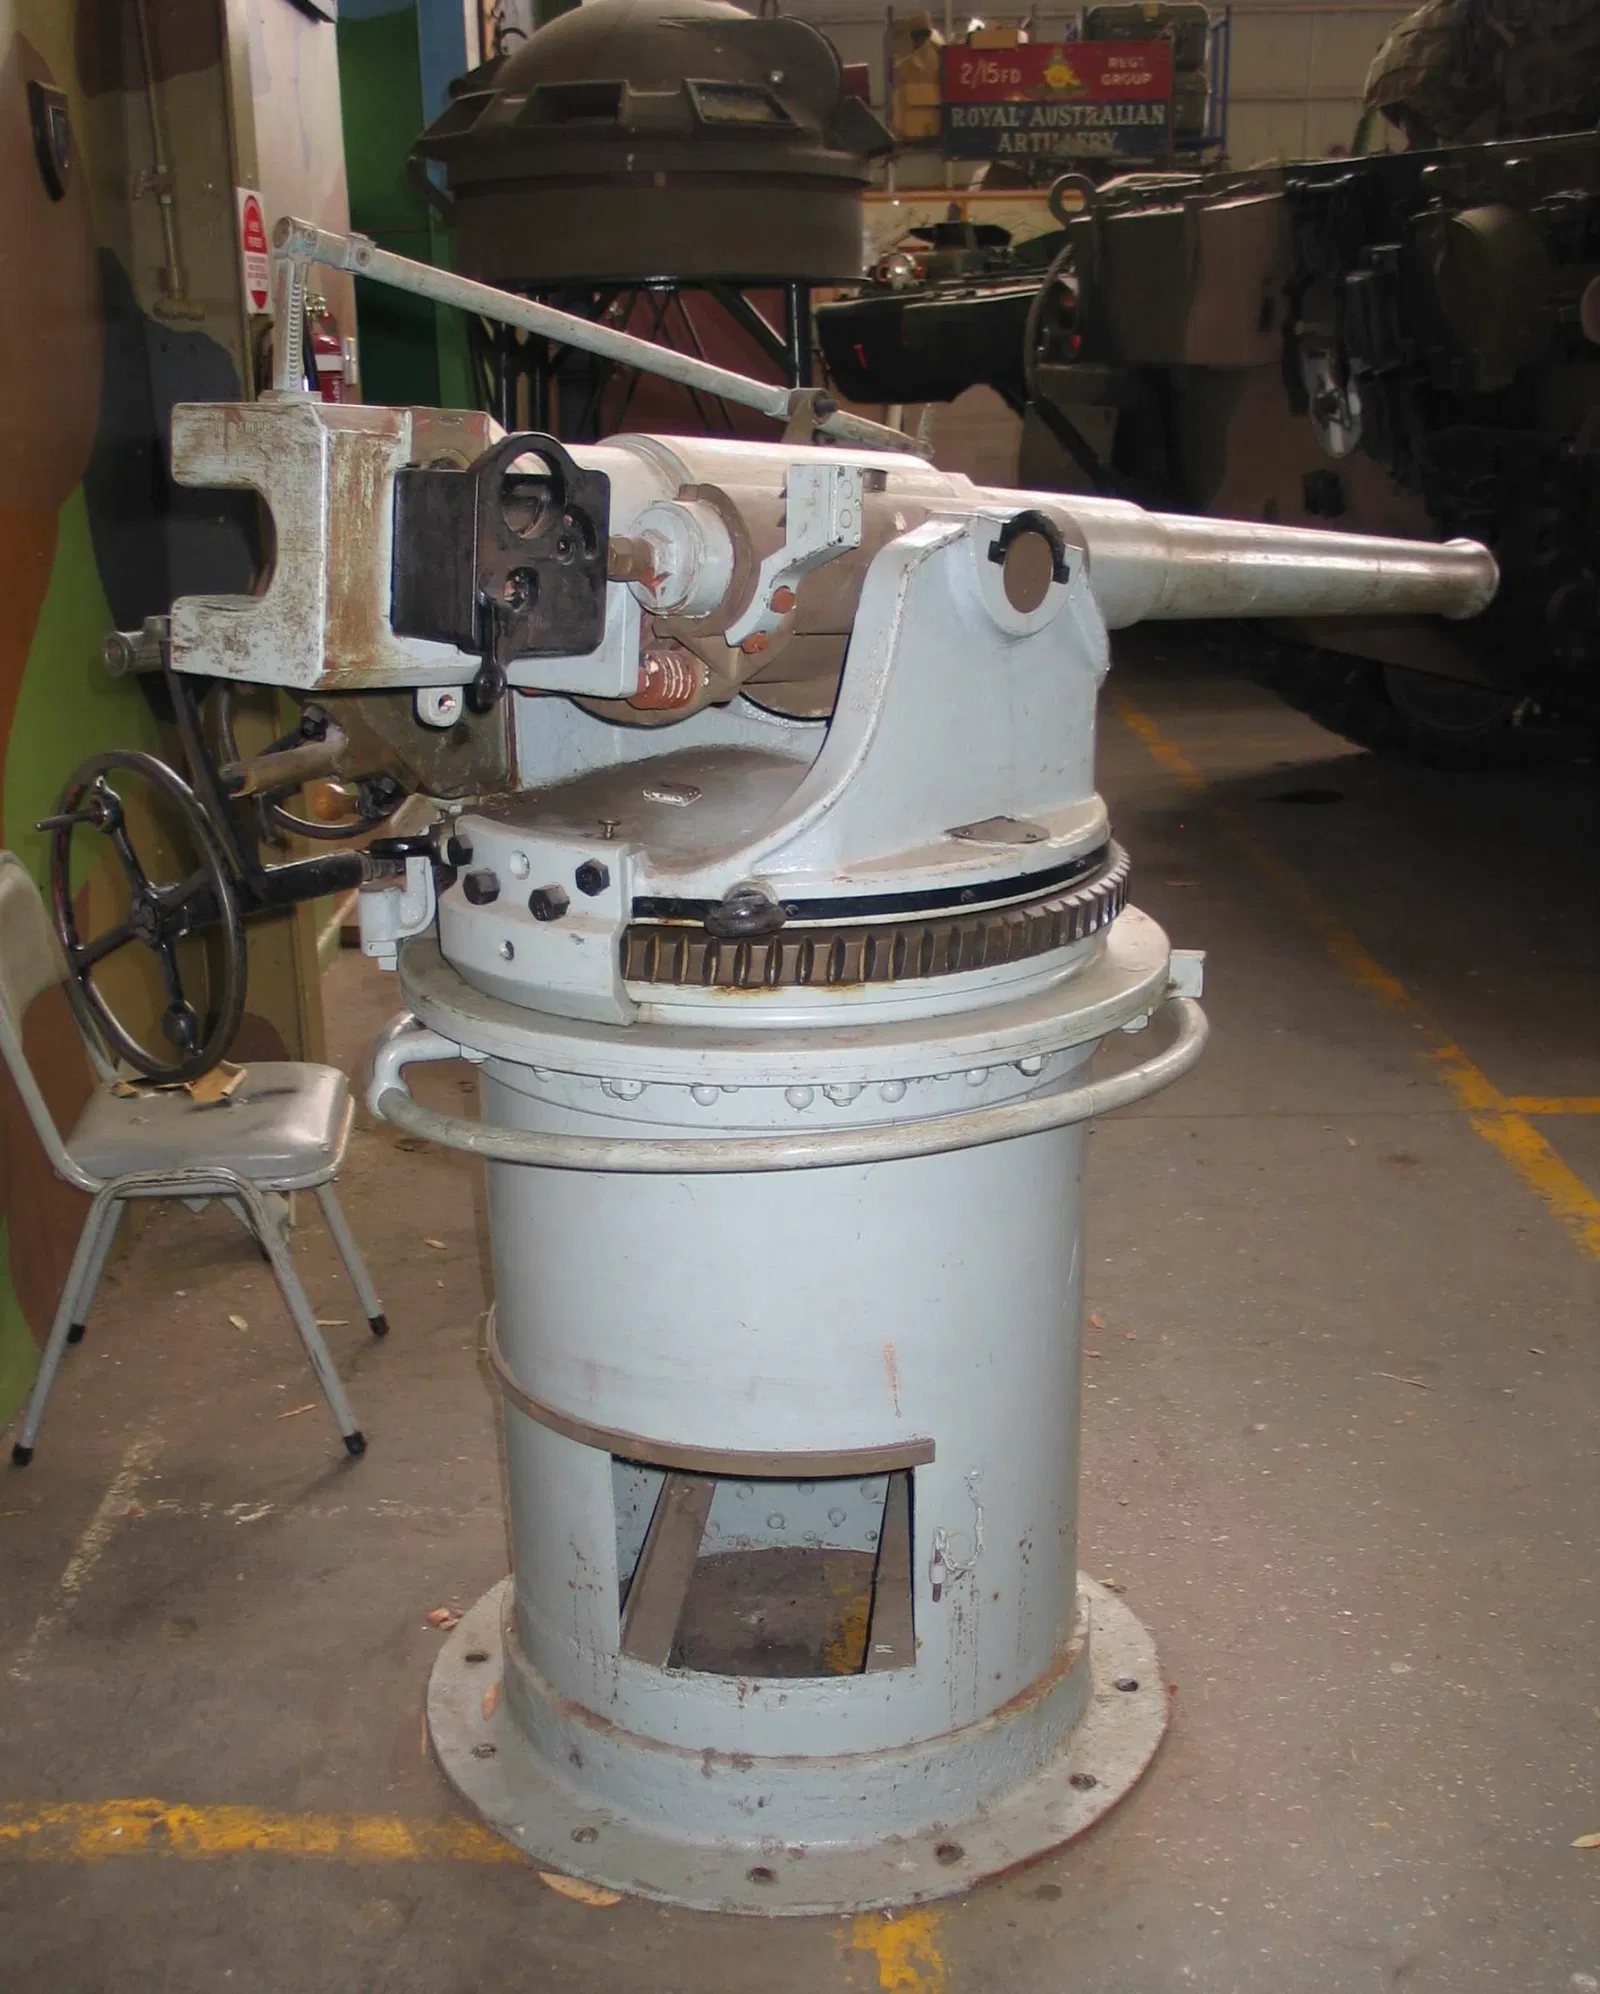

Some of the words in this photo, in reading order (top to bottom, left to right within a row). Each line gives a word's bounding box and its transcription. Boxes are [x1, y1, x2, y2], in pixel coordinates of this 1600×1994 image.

[1101, 72, 1153, 86] GROUP
[951, 107, 1020, 128] ROYAL
[1029, 104, 1166, 126] AUSTRALIAN
